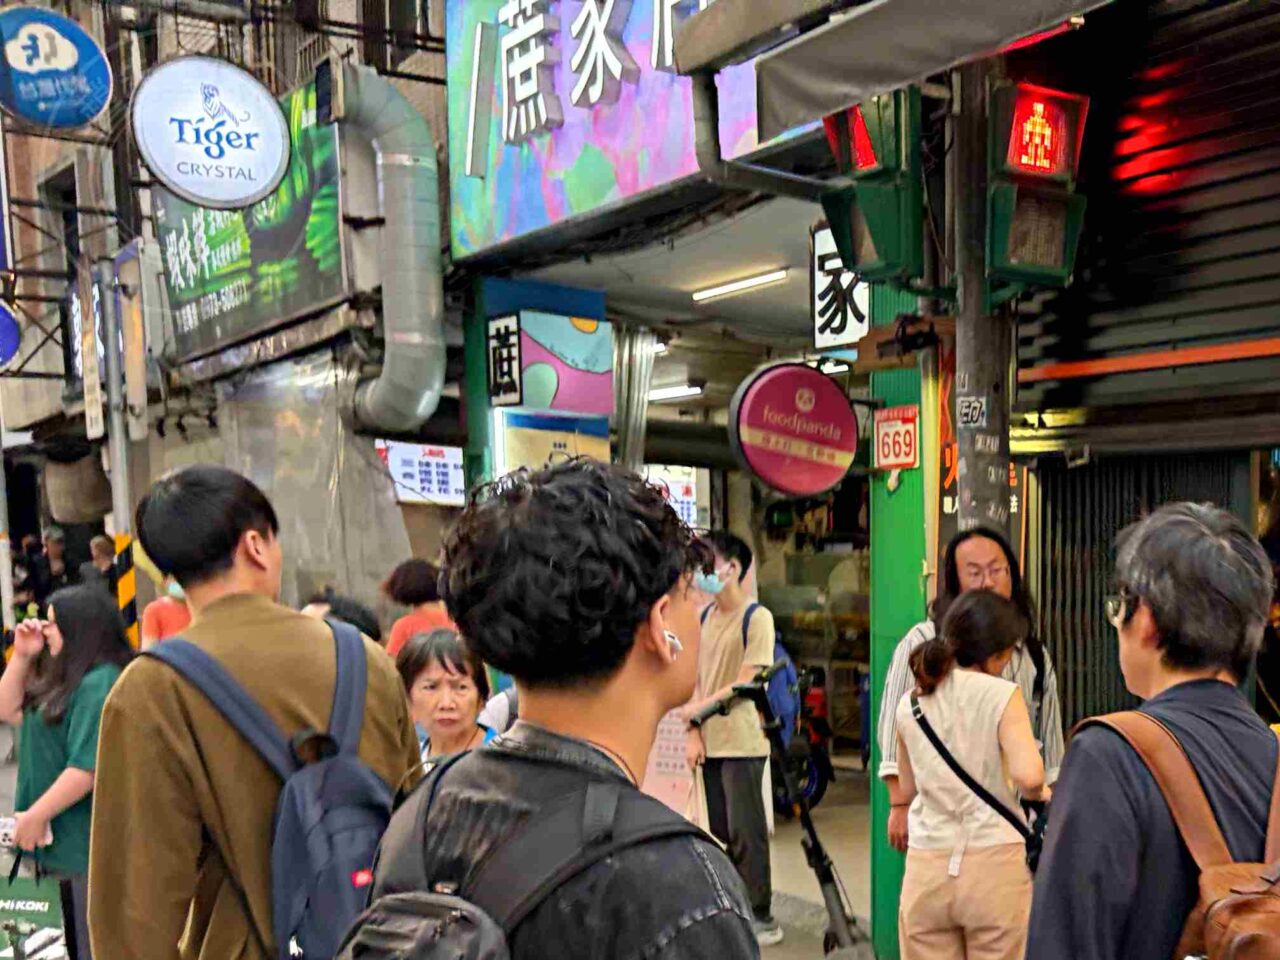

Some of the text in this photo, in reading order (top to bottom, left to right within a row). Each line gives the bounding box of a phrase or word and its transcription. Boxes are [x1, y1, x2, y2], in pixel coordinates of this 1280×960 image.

[498, 0, 706, 142] 蔗家
[168, 117, 259, 159] Tiger
[176, 161, 257, 181] CRYSTAL
[763, 405, 842, 441] foodpanda
[881, 429, 914, 459] 669
